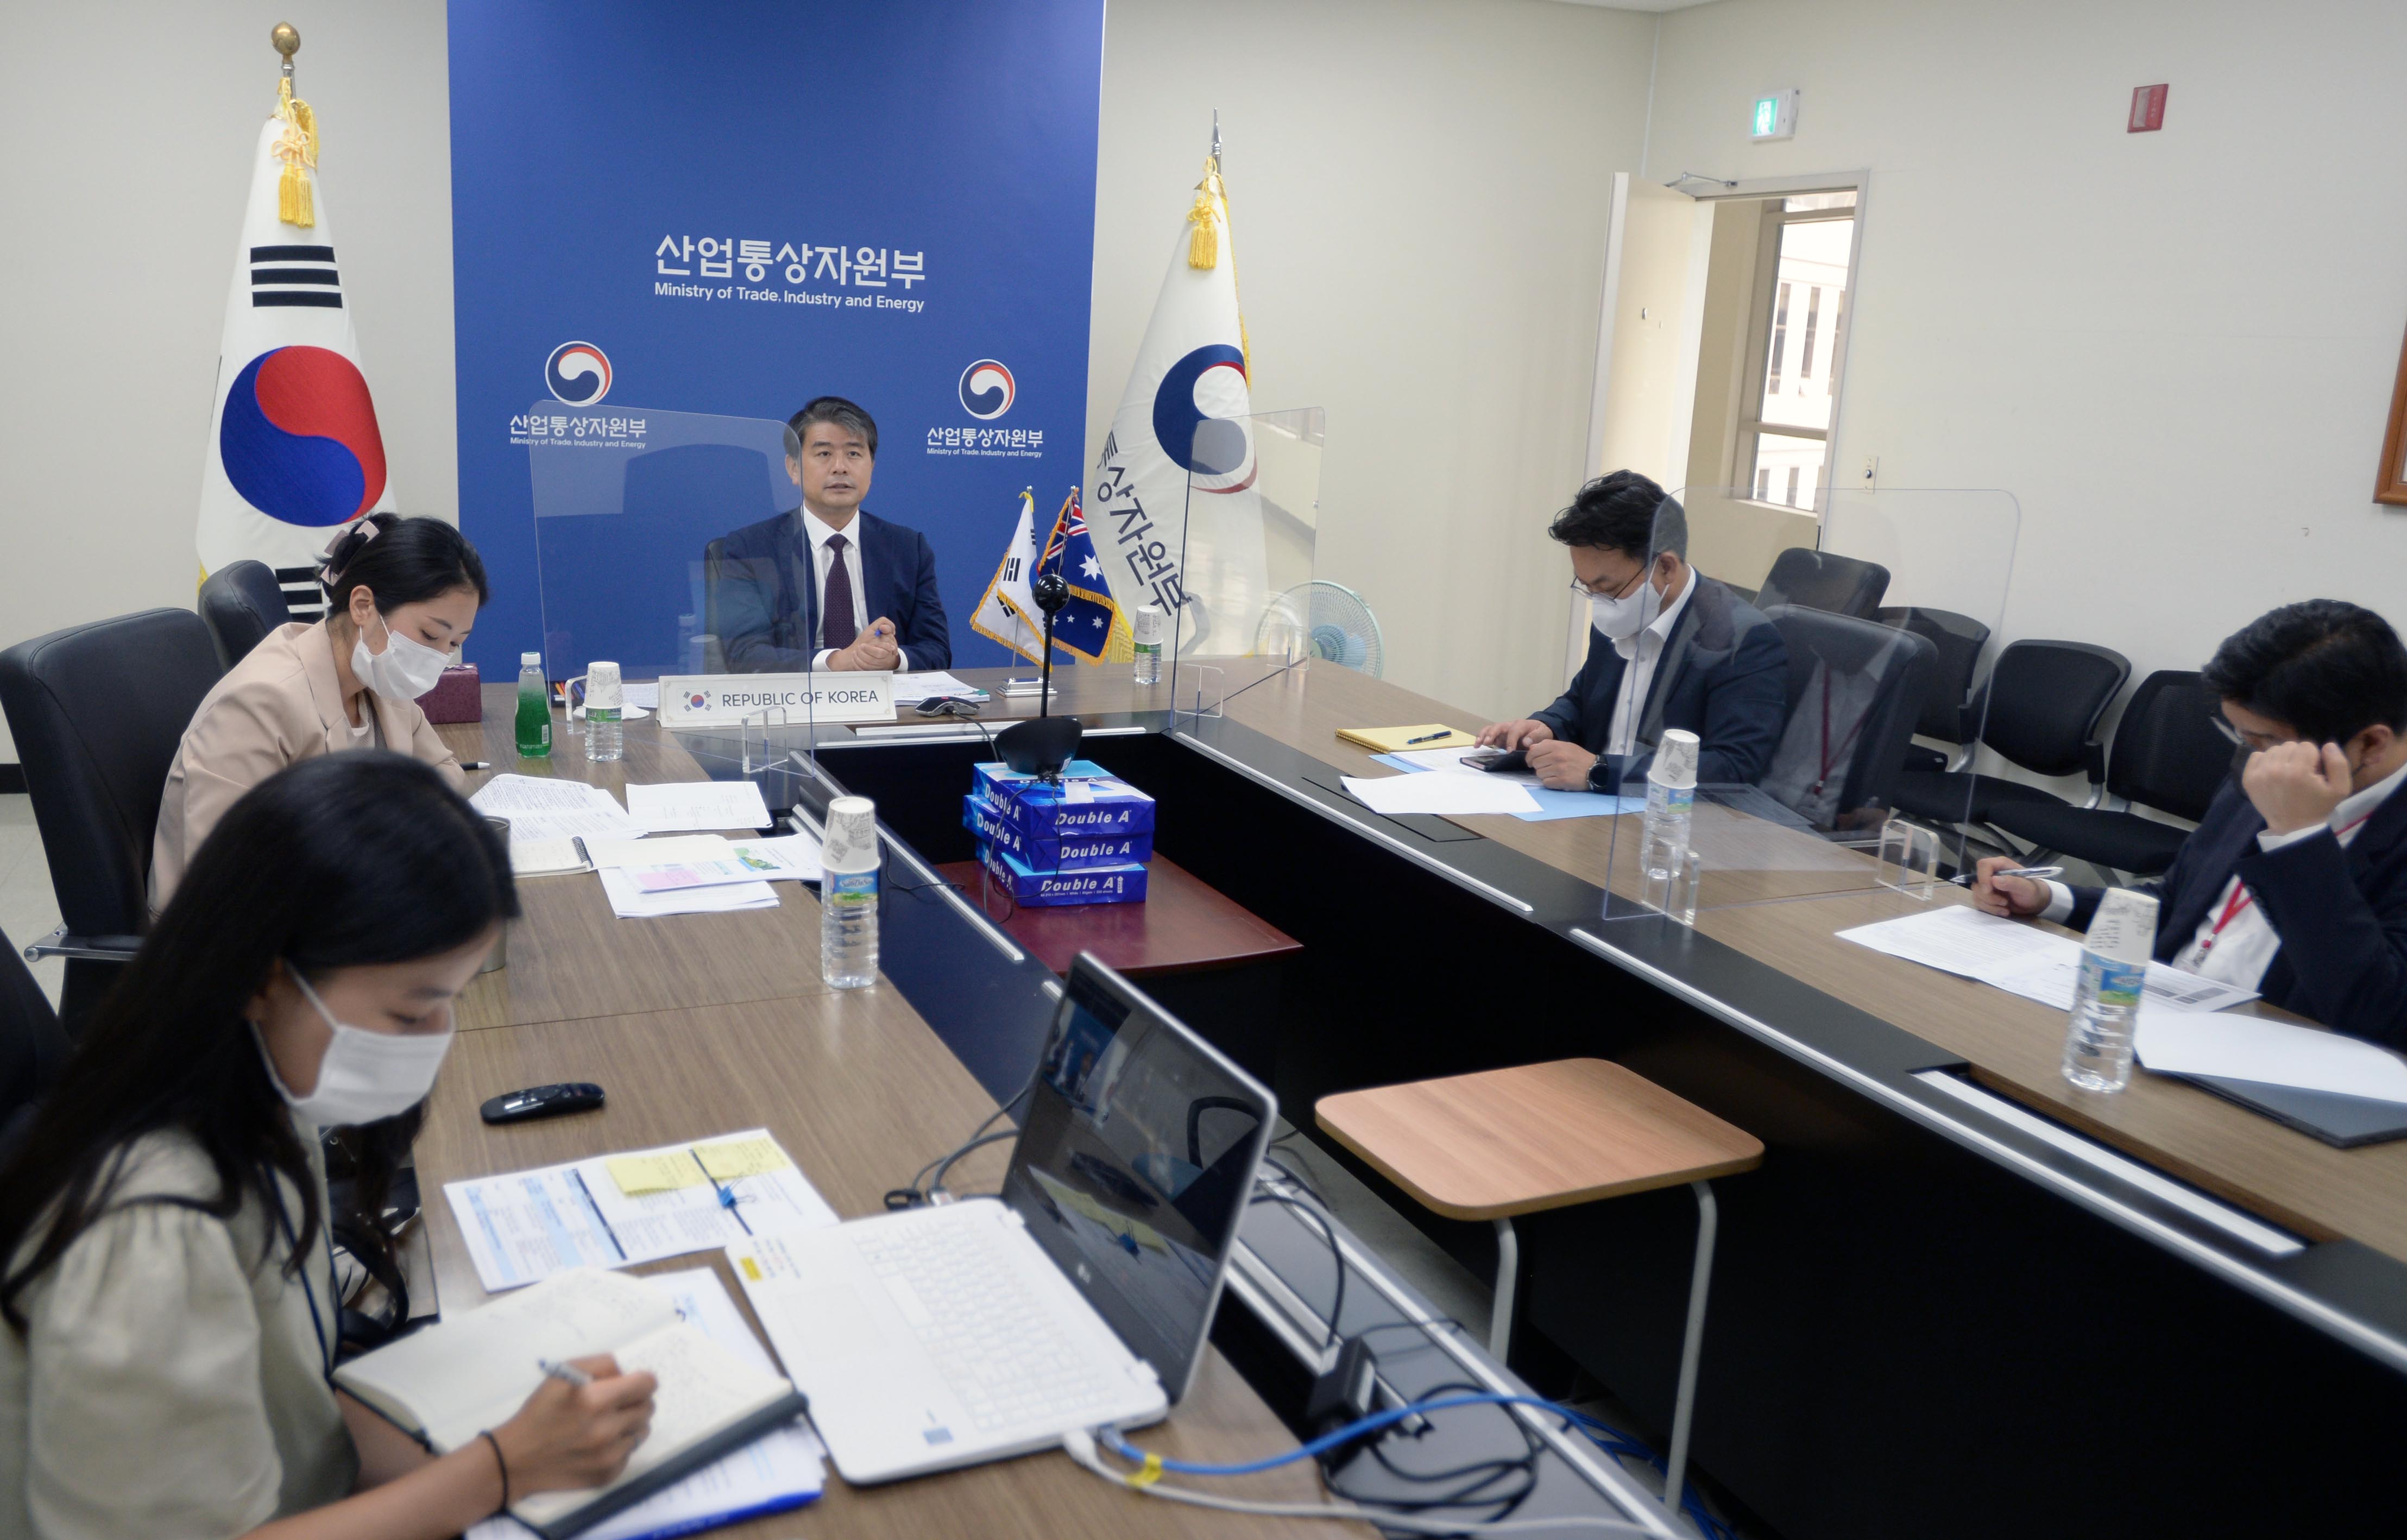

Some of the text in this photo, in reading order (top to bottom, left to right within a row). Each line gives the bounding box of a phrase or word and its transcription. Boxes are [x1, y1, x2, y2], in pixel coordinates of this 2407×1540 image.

[655, 234, 925, 289] 산업통상자원부
[654, 282, 714, 301] Ministry
[717, 286, 733, 299] of
[784, 291, 842, 308] Industry
[845, 294, 872, 307] and
[876, 295, 924, 313] Energy
[509, 414, 647, 439] 산업통상자원부
[510, 437, 539, 446] Ministry
[574, 439, 603, 448] Industry
[621, 440, 646, 449] Energy
[927, 427, 1043, 448] 산업통상자원부
[927, 447, 952, 456] Ministry
[981, 449, 1006, 457] Industry
[1020, 450, 1042, 458] Energy
[722, 690, 879, 707] REPUBLIC OF KOREA
[984, 783, 1011, 815] Double
[1055, 810, 1129, 825] Double A
[1061, 842, 1130, 859] Double A
[1041, 878, 1098, 892] Double
[1102, 877, 1113, 889] A
